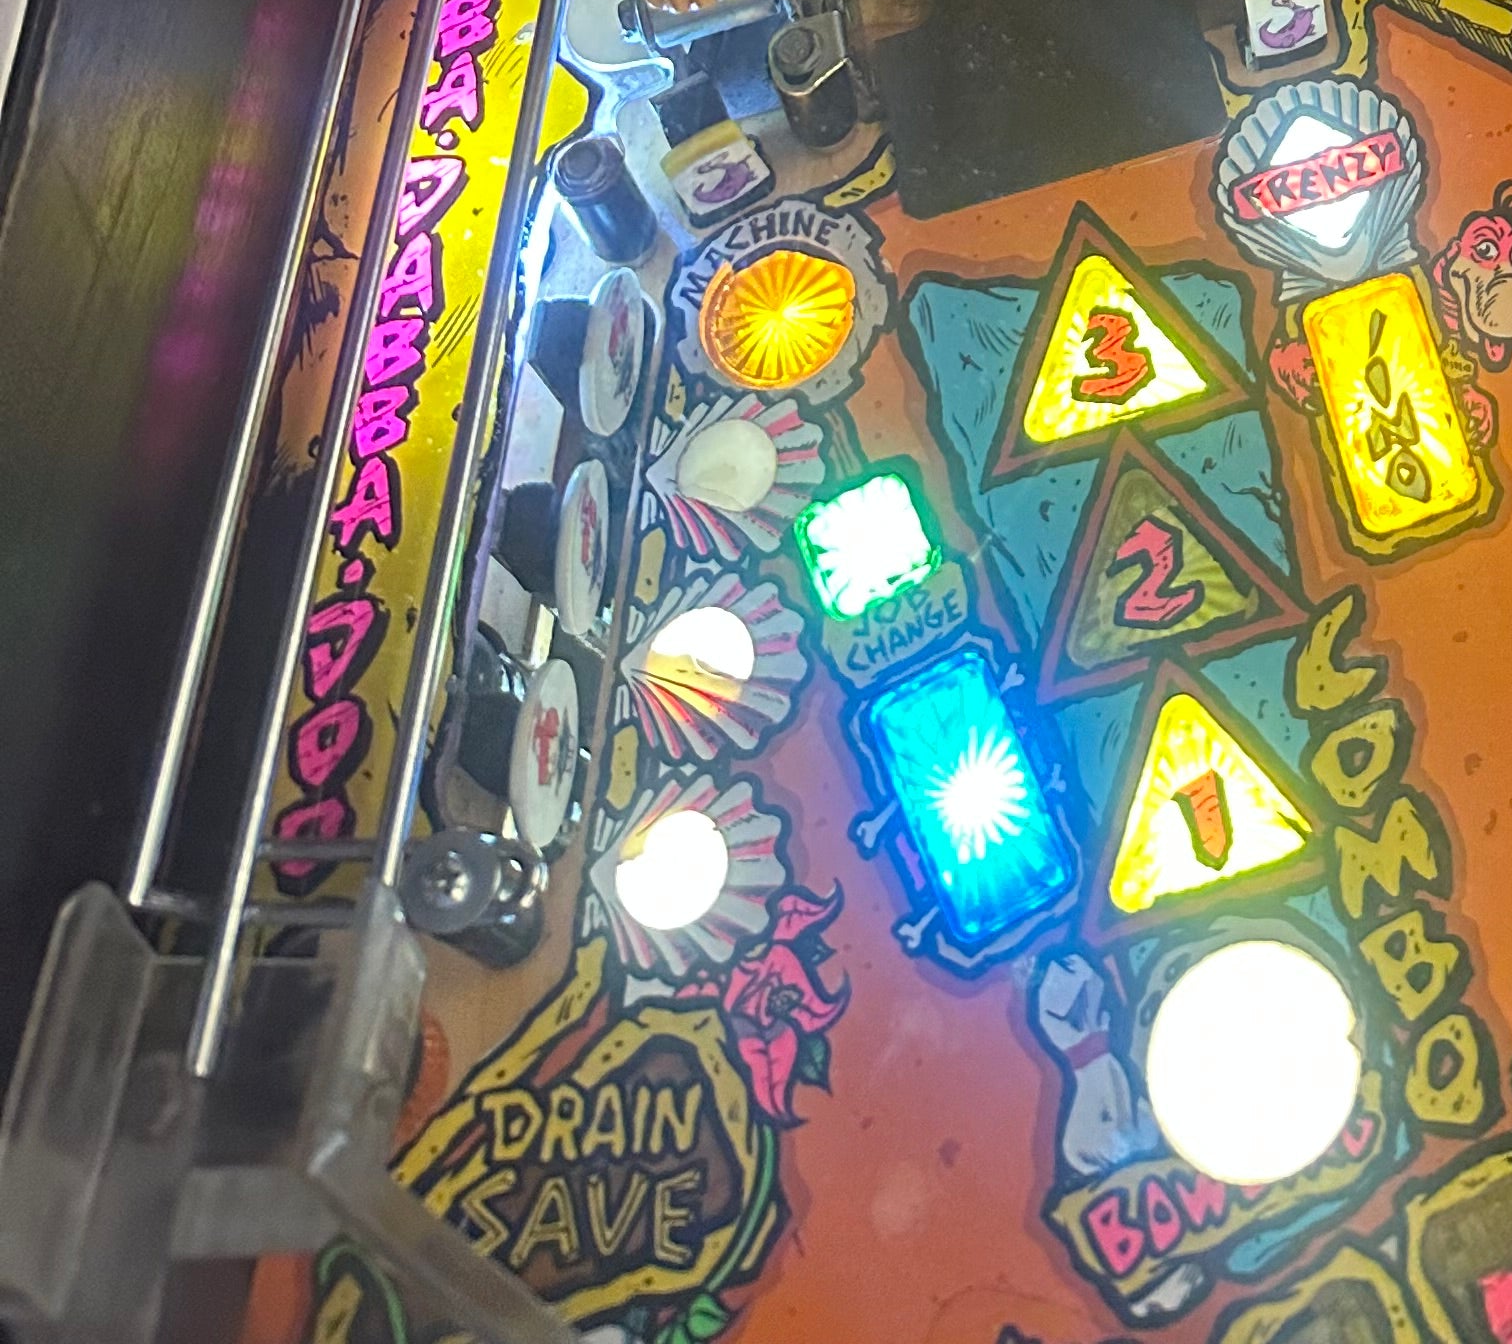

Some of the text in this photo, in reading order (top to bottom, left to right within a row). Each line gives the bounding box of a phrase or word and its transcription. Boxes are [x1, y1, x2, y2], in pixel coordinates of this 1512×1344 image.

[1244, 140, 1400, 209] FRENZY
[681, 211, 841, 310] MACHINE
[1070, 305, 1158, 405] 3
[1108, 512, 1204, 631] 2
[845, 588, 963, 673] CHANGE
[1168, 766, 1238, 874] 1
[1288, 586, 1500, 1138] COMBO
[481, 1080, 705, 1171] DRAIN
[459, 1169, 705, 1273] SAVE
